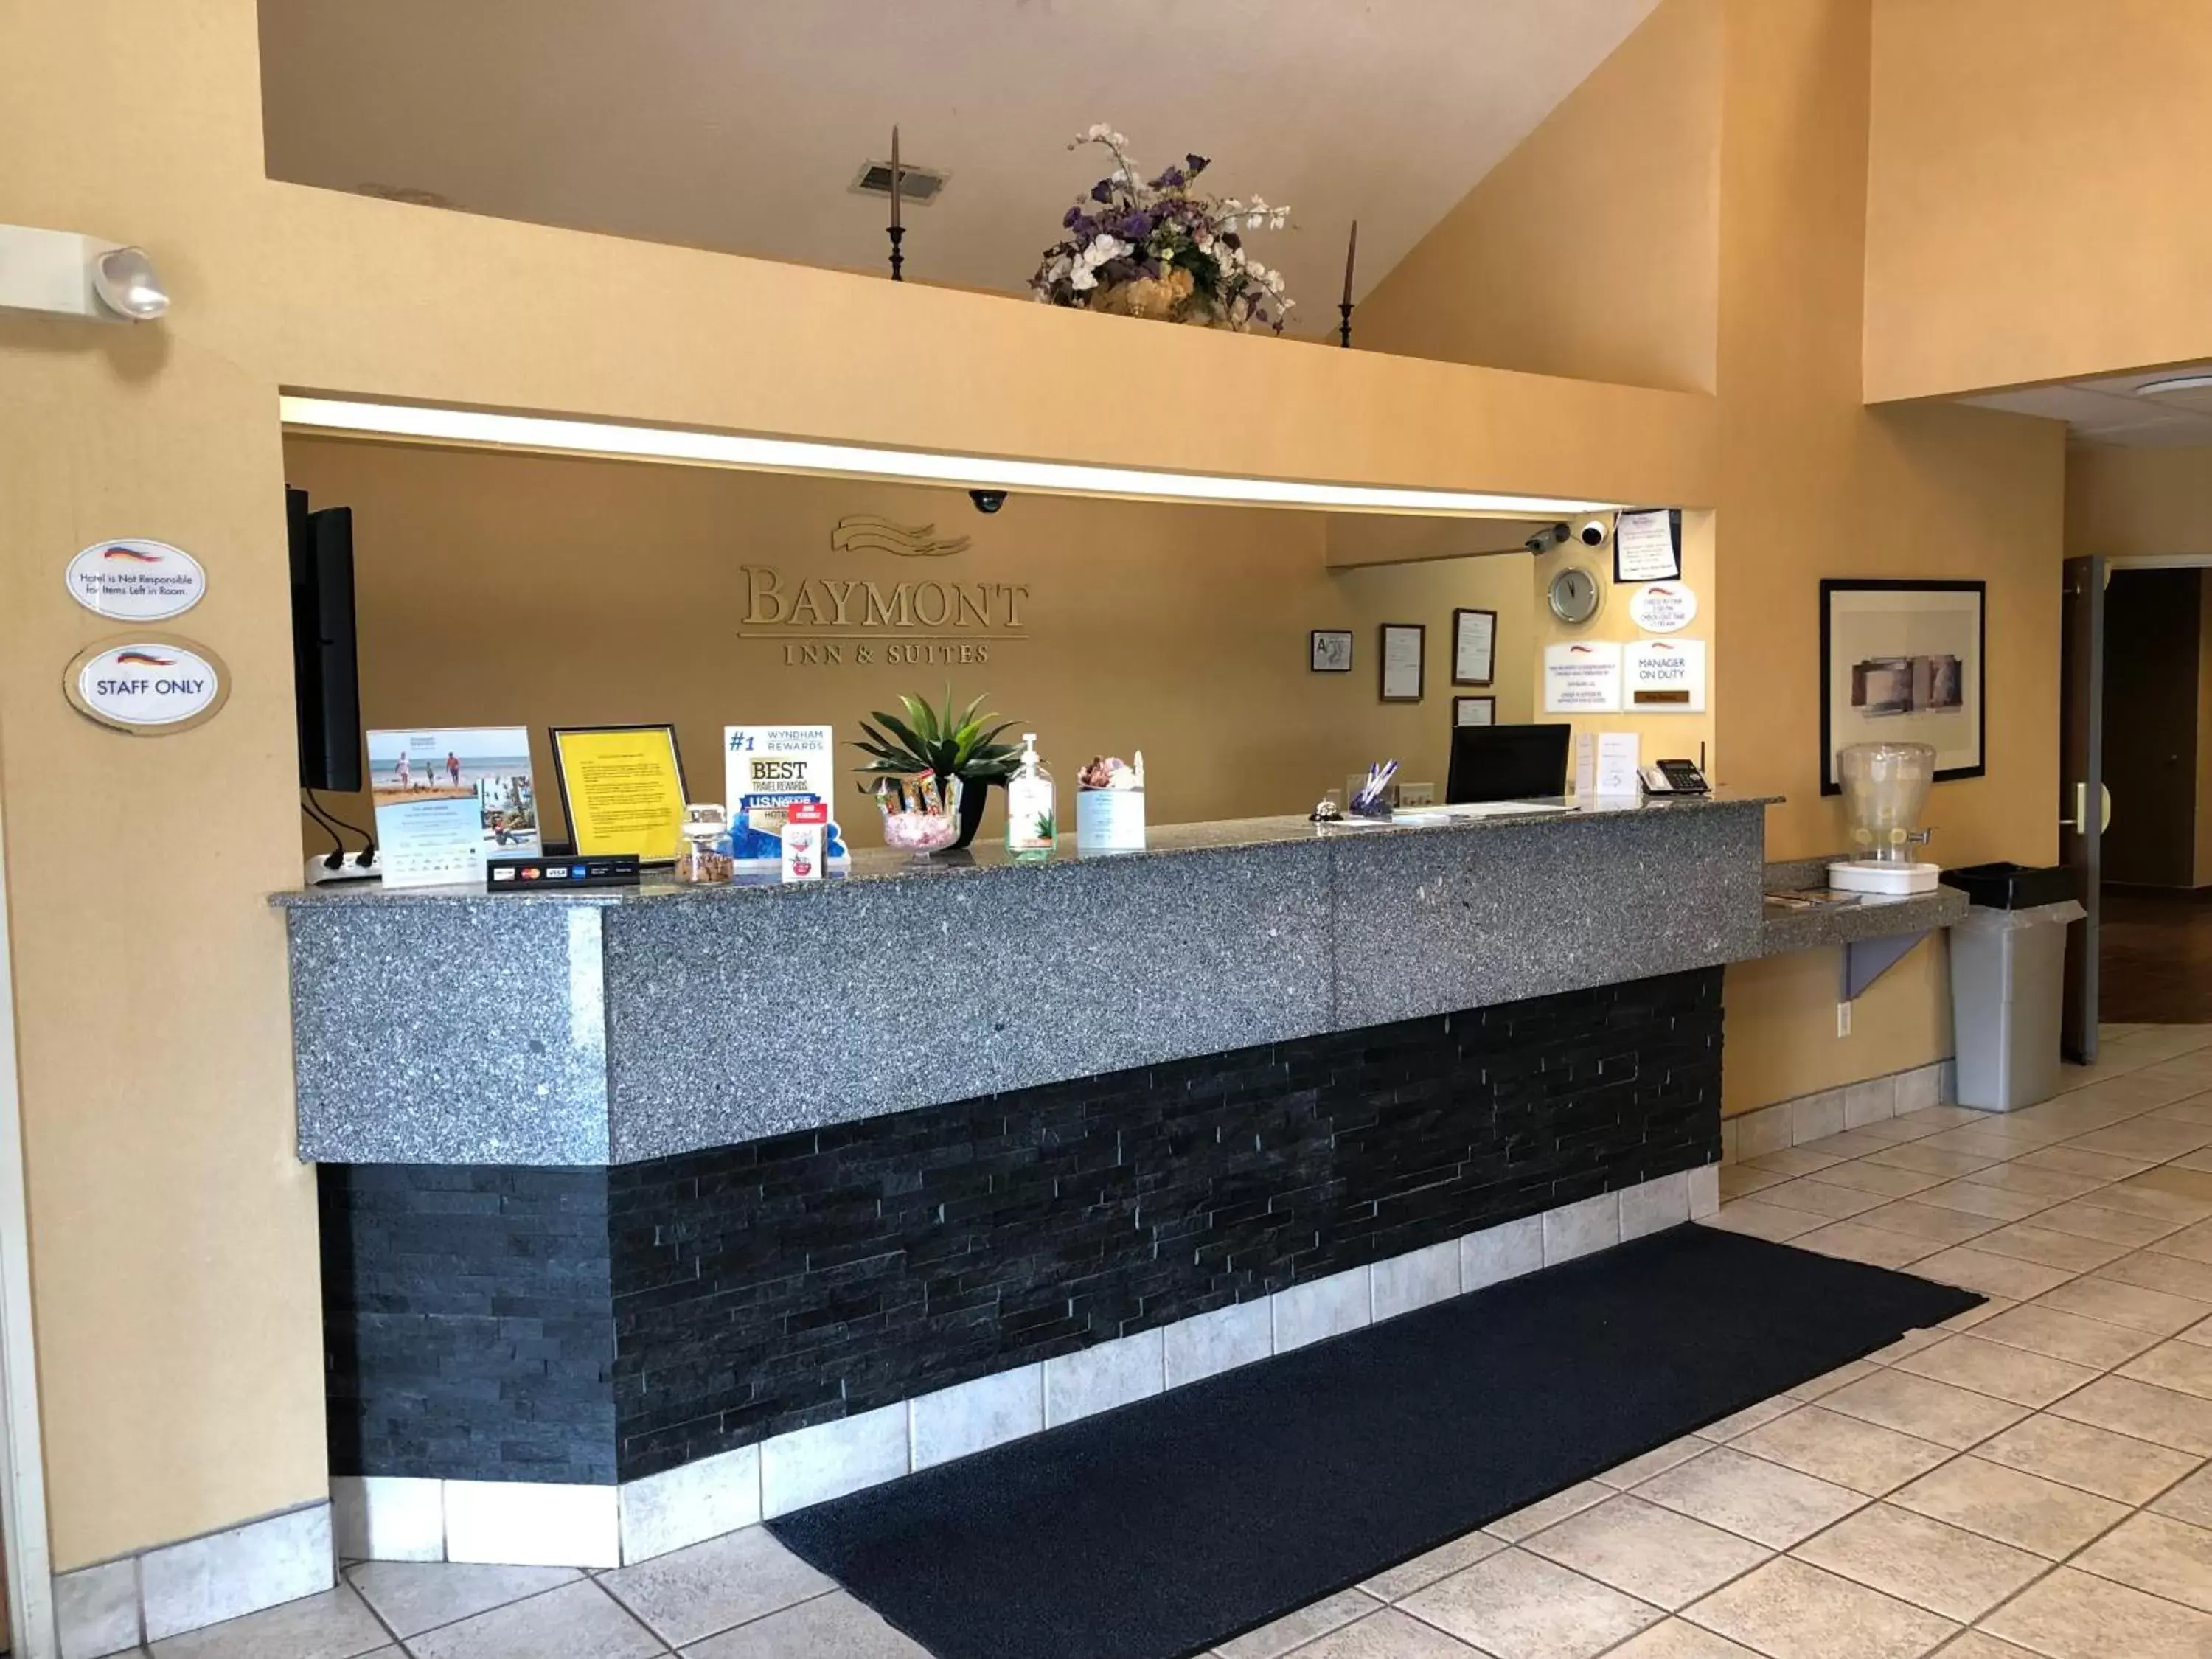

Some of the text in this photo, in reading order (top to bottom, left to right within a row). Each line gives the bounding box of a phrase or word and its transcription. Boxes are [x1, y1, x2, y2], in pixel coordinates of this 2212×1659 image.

[80, 573, 192, 585] Hotel is Not Responsible
[102, 585, 126, 594] Items
[130, 585, 146, 594] Left
[740, 565, 1031, 627] BAYMONT
[783, 644, 990, 666] INN & SUITES
[1639, 658, 1686, 668] MANAGER
[1639, 669, 1686, 679] ON DUTY
[97, 679, 204, 695] STAFF ONLY
[730, 731, 754, 751] #1
[768, 731, 824, 740] WYNDHAM
[768, 742, 824, 751] REWARDS
[752, 761, 807, 779] BEST
